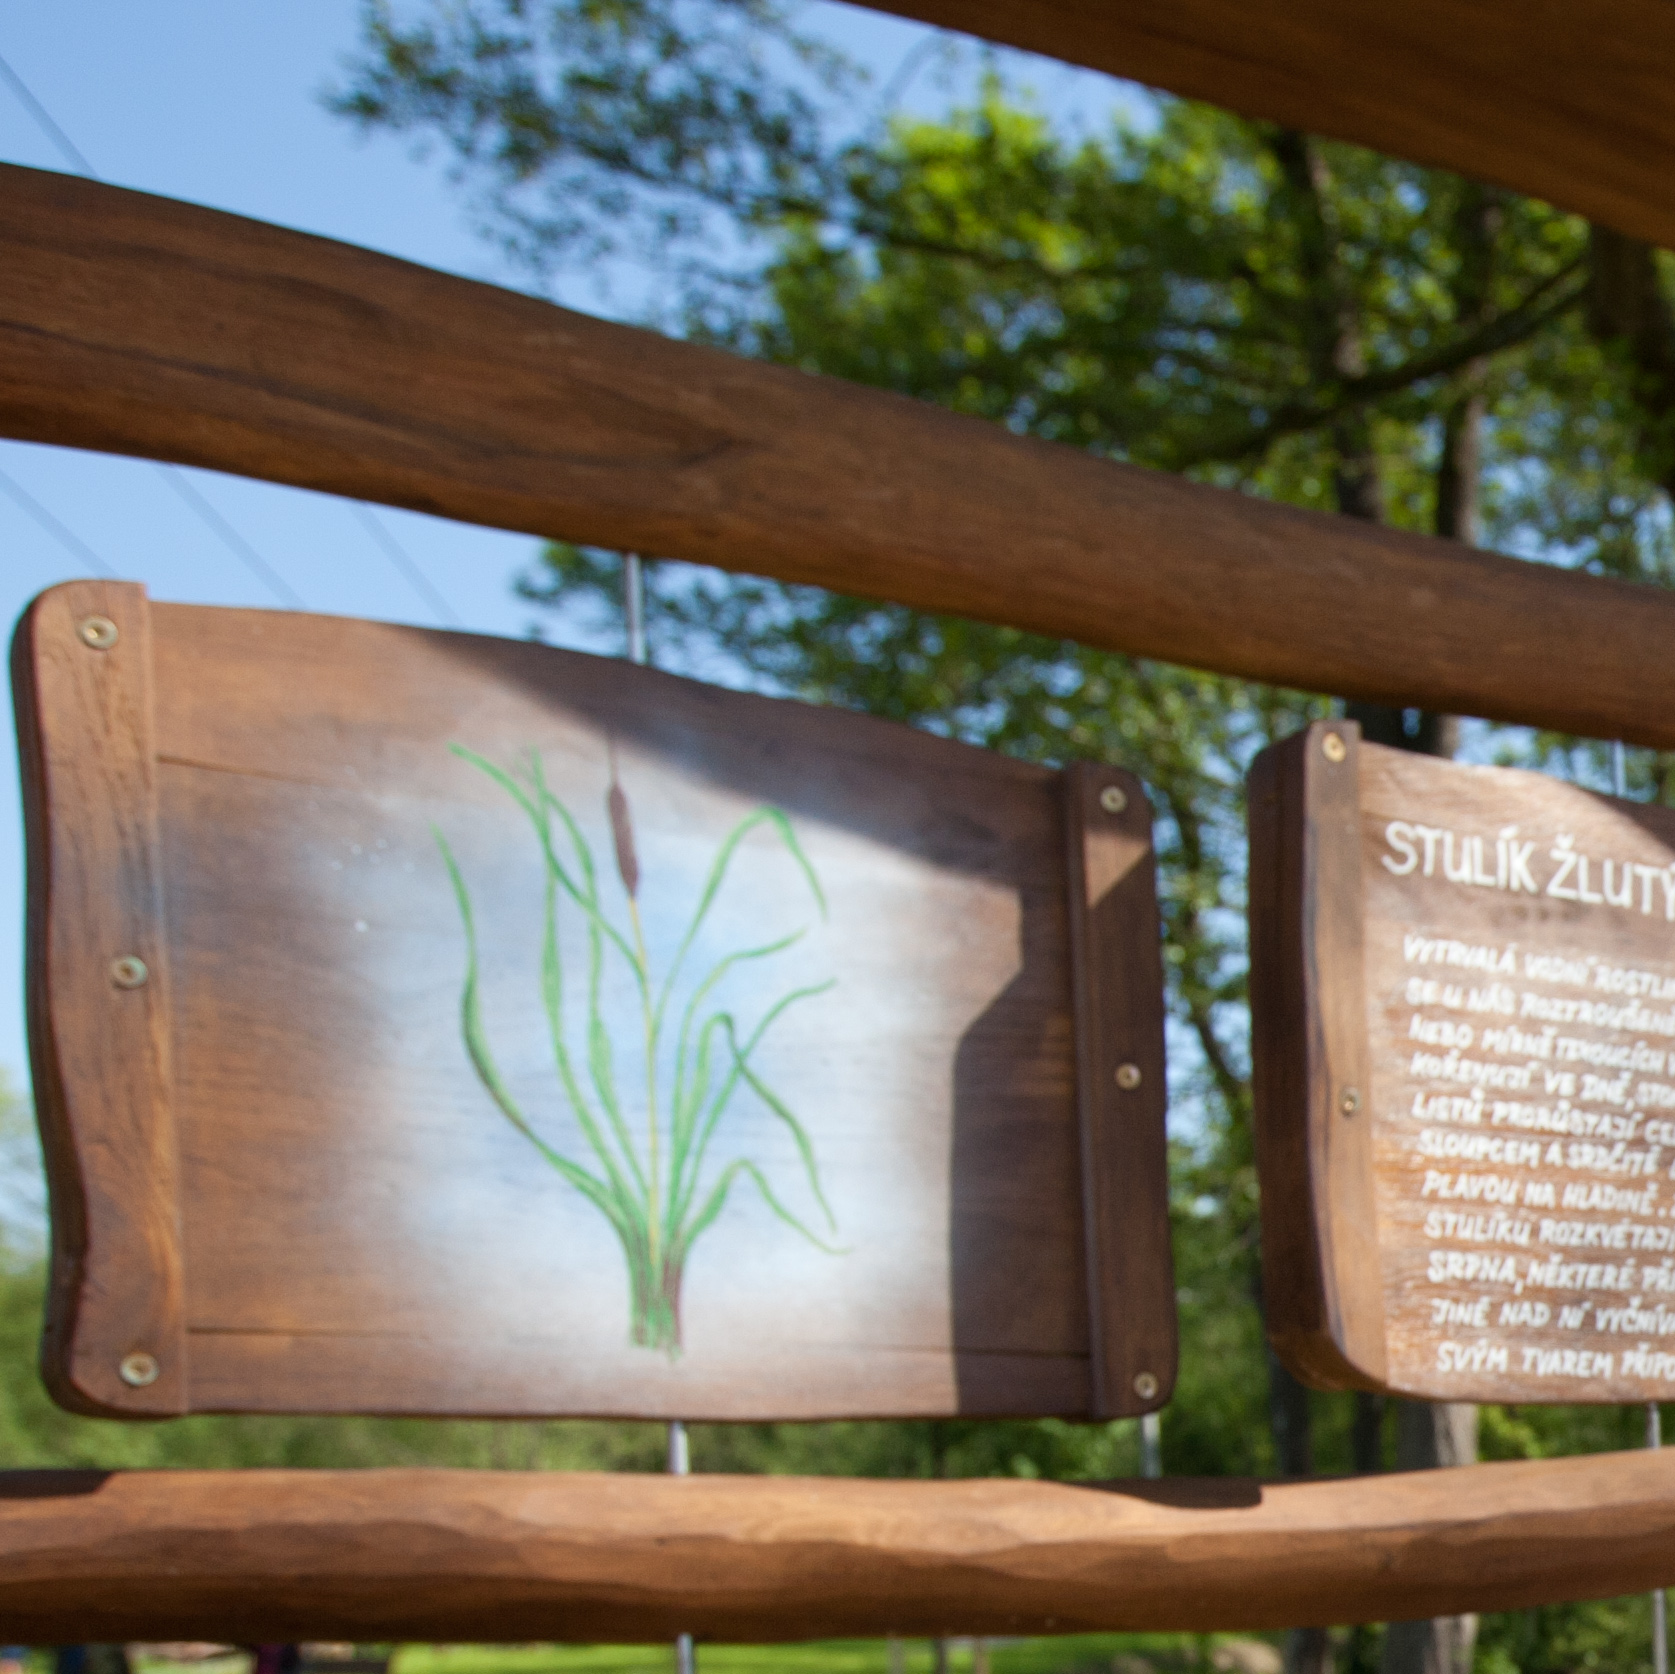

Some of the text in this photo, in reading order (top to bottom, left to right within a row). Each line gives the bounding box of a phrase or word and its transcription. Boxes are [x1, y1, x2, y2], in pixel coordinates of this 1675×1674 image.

[1382, 821, 1538, 893] STULÍK
[1404, 934, 1518, 975] VYTRVALÁ
[1524, 953, 1597, 986] VODNÍ
[1405, 976, 1438, 1006] SE
[1442, 984, 1463, 1008] U
[1467, 981, 1516, 1016] NÁS
[1408, 1013, 1474, 1049] NEBO
[1482, 1024, 1558, 1059] MÍRNĚ
[1556, 1036, 1666, 1075] TEKOUCÍCH
[1410, 1049, 1541, 1090] KOŘENUJÍ
[1544, 1069, 1576, 1097] VE
[1411, 1085, 1486, 1125] LISTŮ
[1491, 1099, 1644, 1141] PRORŮSTAJÍ
[1416, 1128, 1542, 1169] SLOUPCEM
[1544, 1139, 1563, 1167] A
[1421, 1168, 1520, 1205] PLAVOU
[1524, 1180, 1556, 1209] NA
[1562, 1180, 1666, 1218] HLADINĚ.
[1424, 1209, 1532, 1247] STULÍKU
[1427, 1249, 1524, 1295] SRPNA,
[1526, 1252, 1636, 1291] NĚKTERÉ
[1430, 1295, 1492, 1328] JINÉ
[1498, 1300, 1551, 1328] NAD
[1556, 1299, 1593, 1330] NÍ
[1436, 1337, 1509, 1374] SVÝM
[1521, 1346, 1614, 1381] TVAREM
